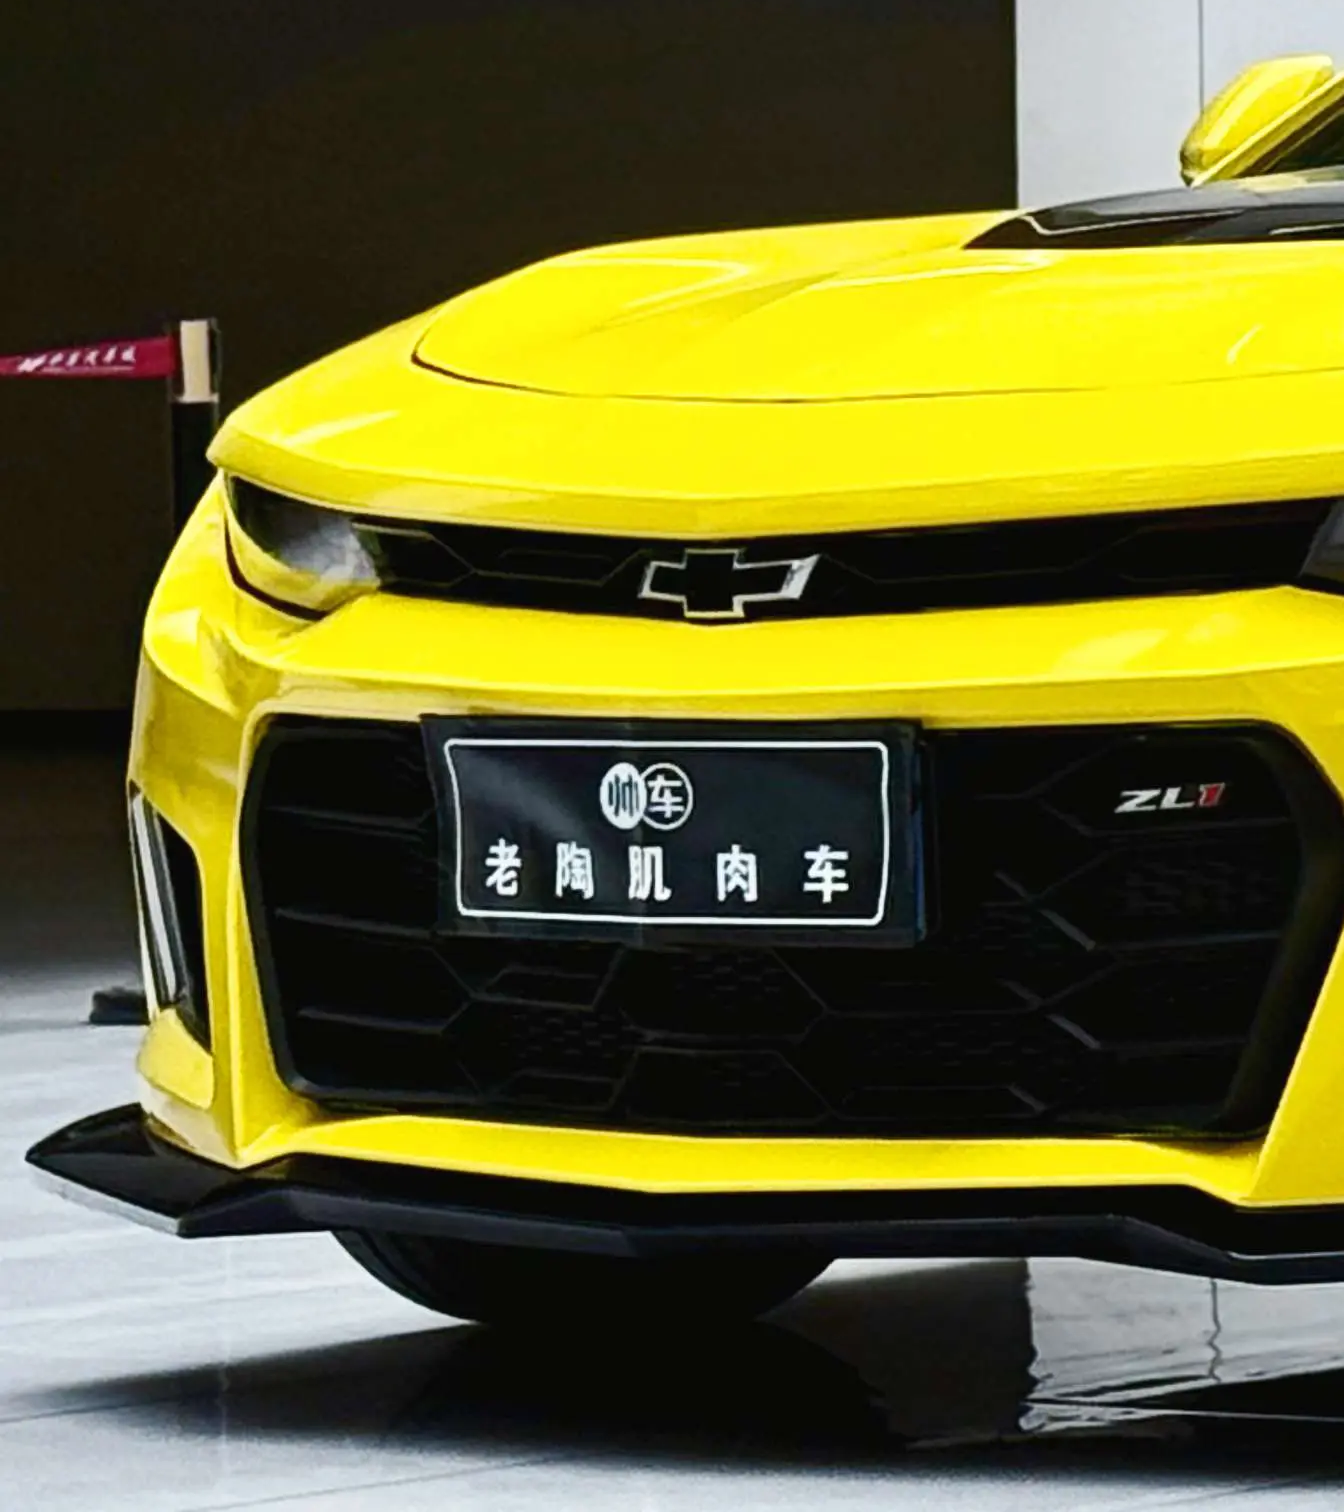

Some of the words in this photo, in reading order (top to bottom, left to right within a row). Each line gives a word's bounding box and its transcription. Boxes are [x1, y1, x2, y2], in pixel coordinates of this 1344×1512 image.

[1114, 782, 1226, 813] ZL1
[485, 838, 850, 904] 老陶肌肉车
